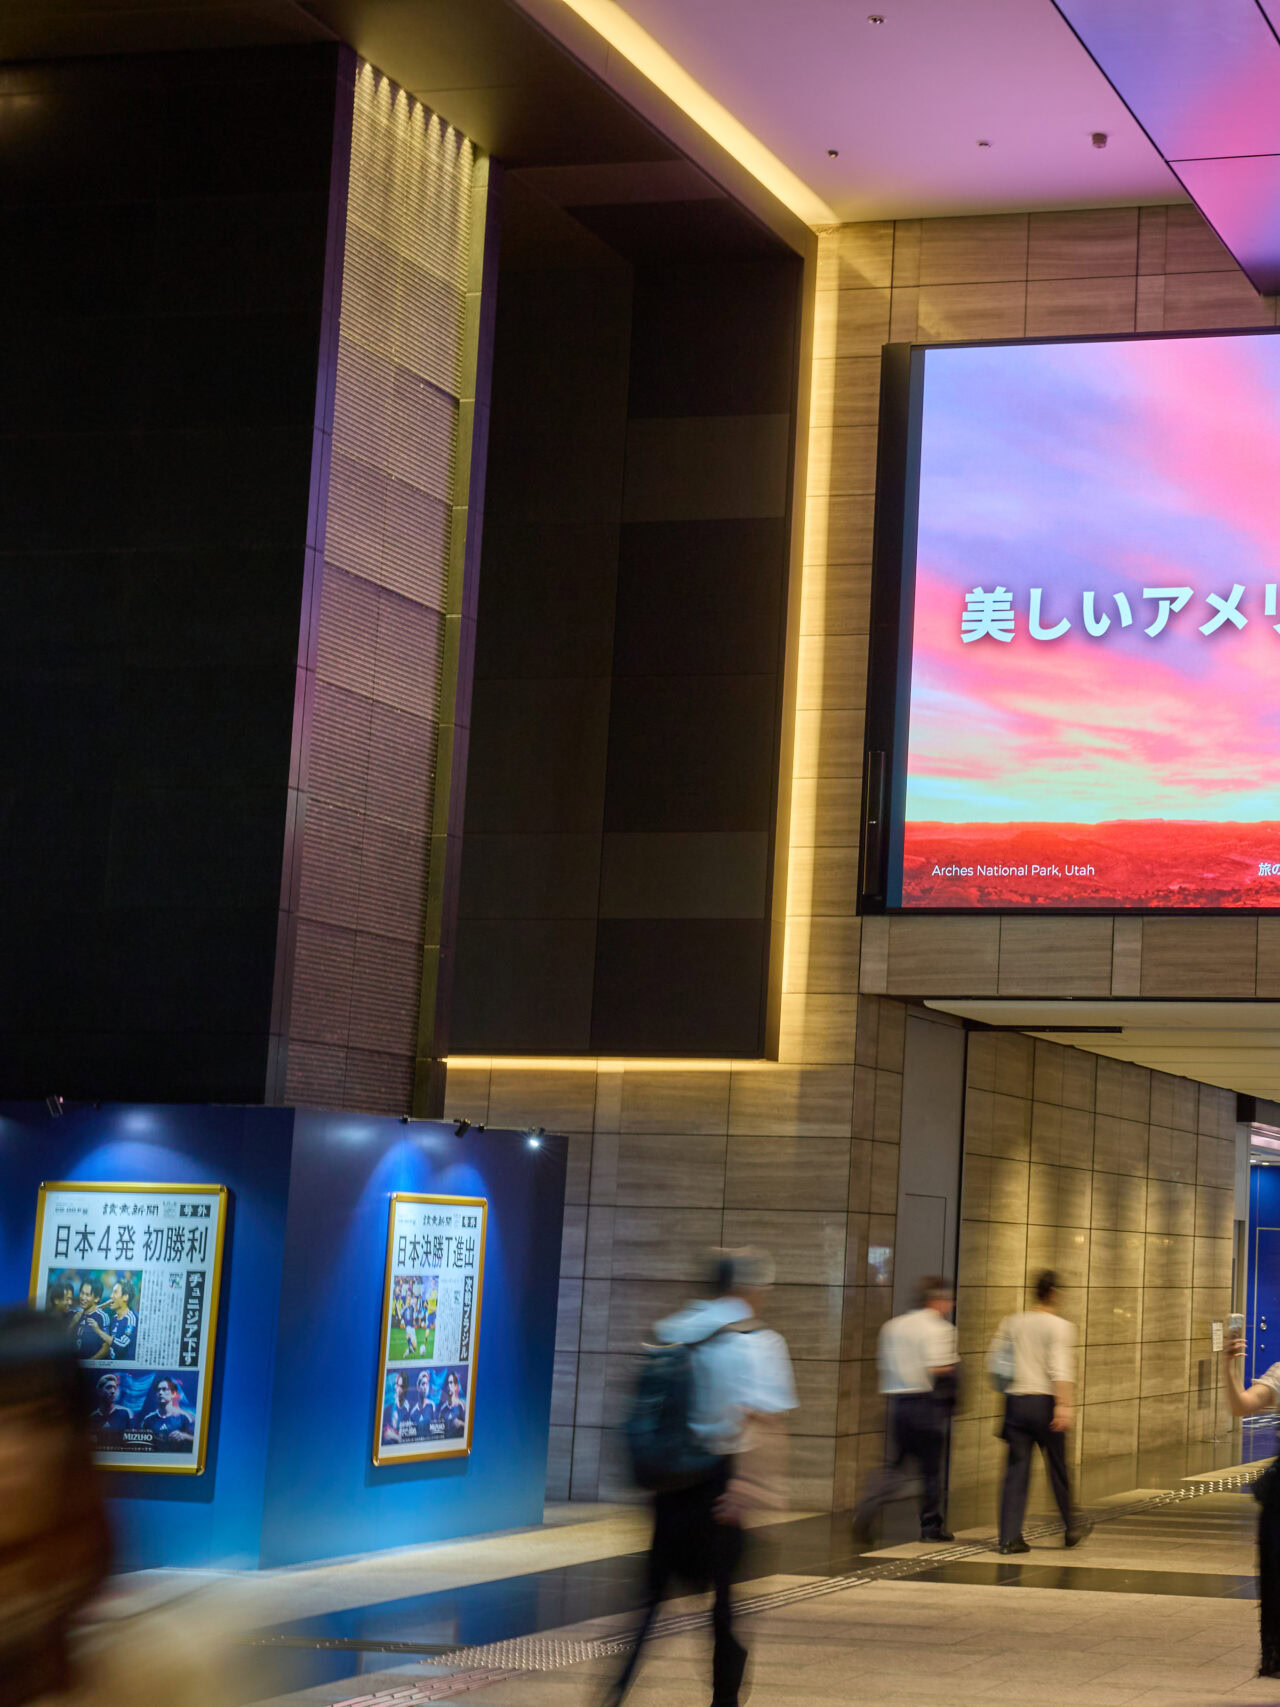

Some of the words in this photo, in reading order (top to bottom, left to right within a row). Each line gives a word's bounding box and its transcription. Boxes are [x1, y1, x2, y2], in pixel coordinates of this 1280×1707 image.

[931, 865, 974, 876] Arches
[977, 865, 1028, 876] National
[1031, 865, 1061, 877] Park,
[1065, 865, 1095, 876] Utah
[142, 1225, 209, 1263] 初勝利
[397, 1233, 475, 1269] 日本決勝T進出
[183, 1272, 203, 1366] チュニジア下す
[123, 1433, 153, 1441] MIZUHO
